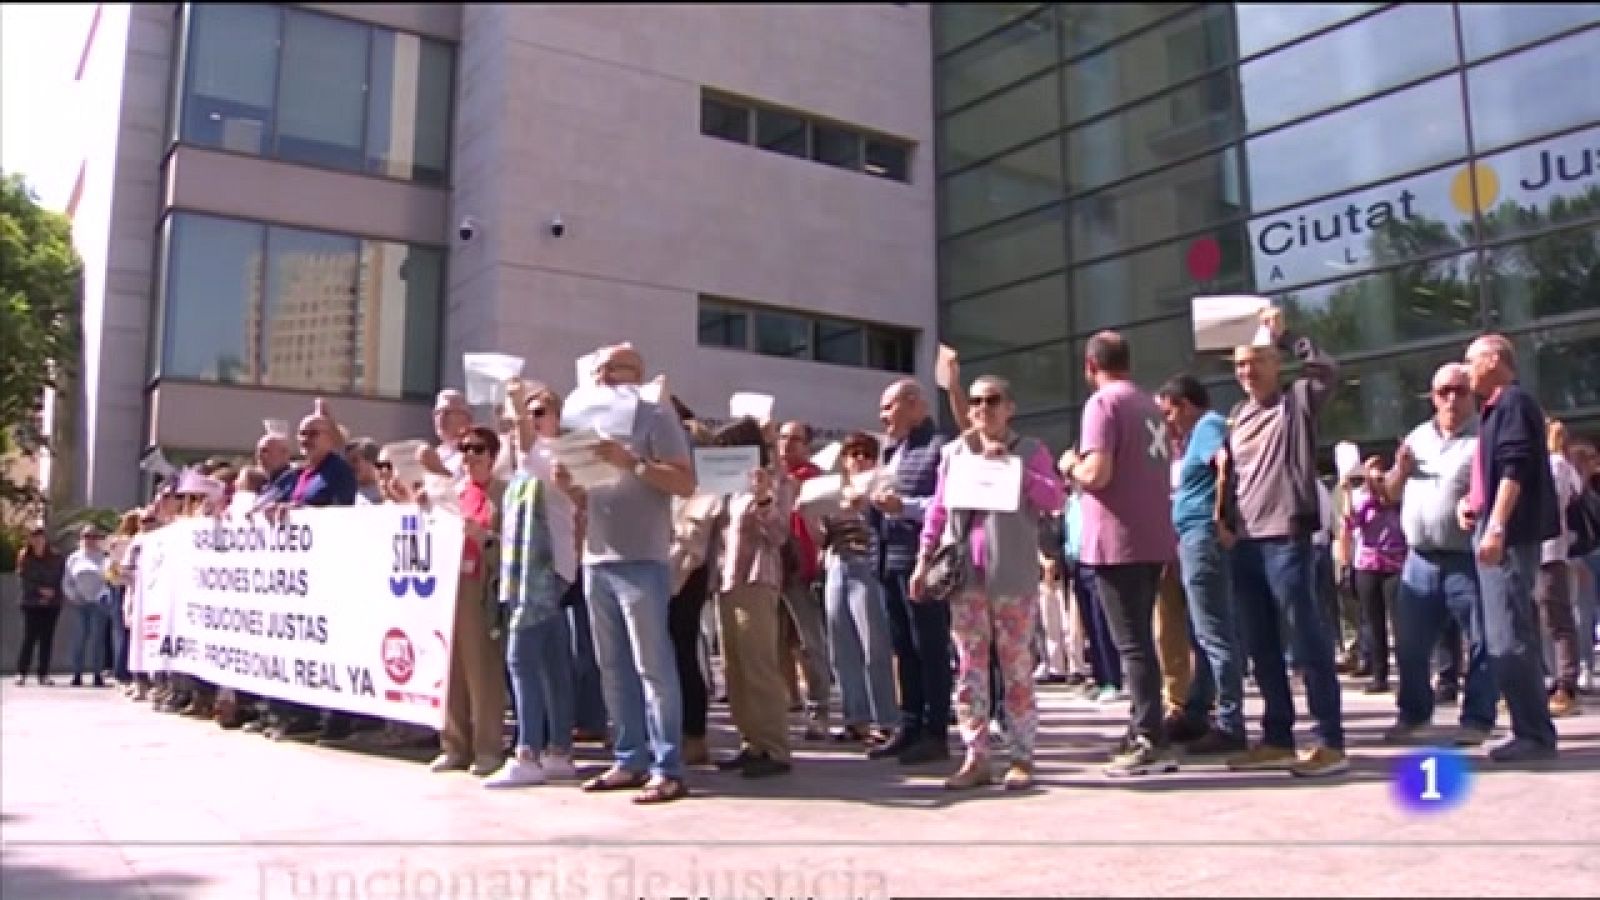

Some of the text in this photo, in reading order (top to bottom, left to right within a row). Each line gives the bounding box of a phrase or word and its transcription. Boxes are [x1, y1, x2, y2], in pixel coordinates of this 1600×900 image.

[1257, 146, 1600, 256] Ciutat Ju
[251, 566, 308, 597] CLARAS
[267, 612, 328, 645] JUSTAS
[294, 657, 342, 693] REAL
[347, 664, 376, 699] YA
